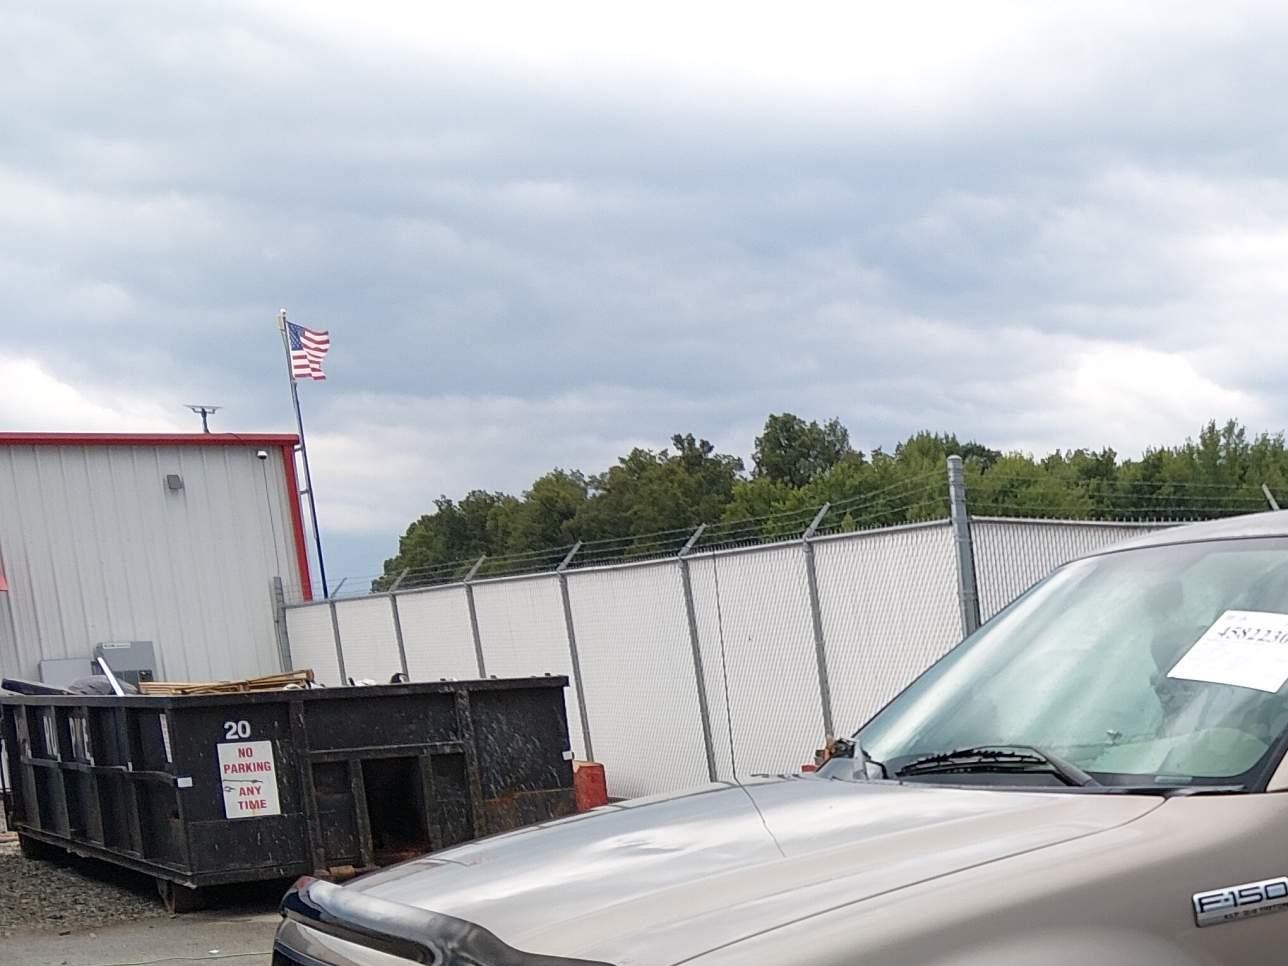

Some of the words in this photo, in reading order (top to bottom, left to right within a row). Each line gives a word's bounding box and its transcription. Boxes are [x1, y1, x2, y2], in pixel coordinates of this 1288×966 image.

[223, 720, 251, 740] 20
[238, 747, 253, 758] NO
[223, 761, 272, 774] PARKING
[239, 786, 261, 797] ANY
[238, 799, 267, 811] TIME
[1198, 881, 1288, 914] F-150
